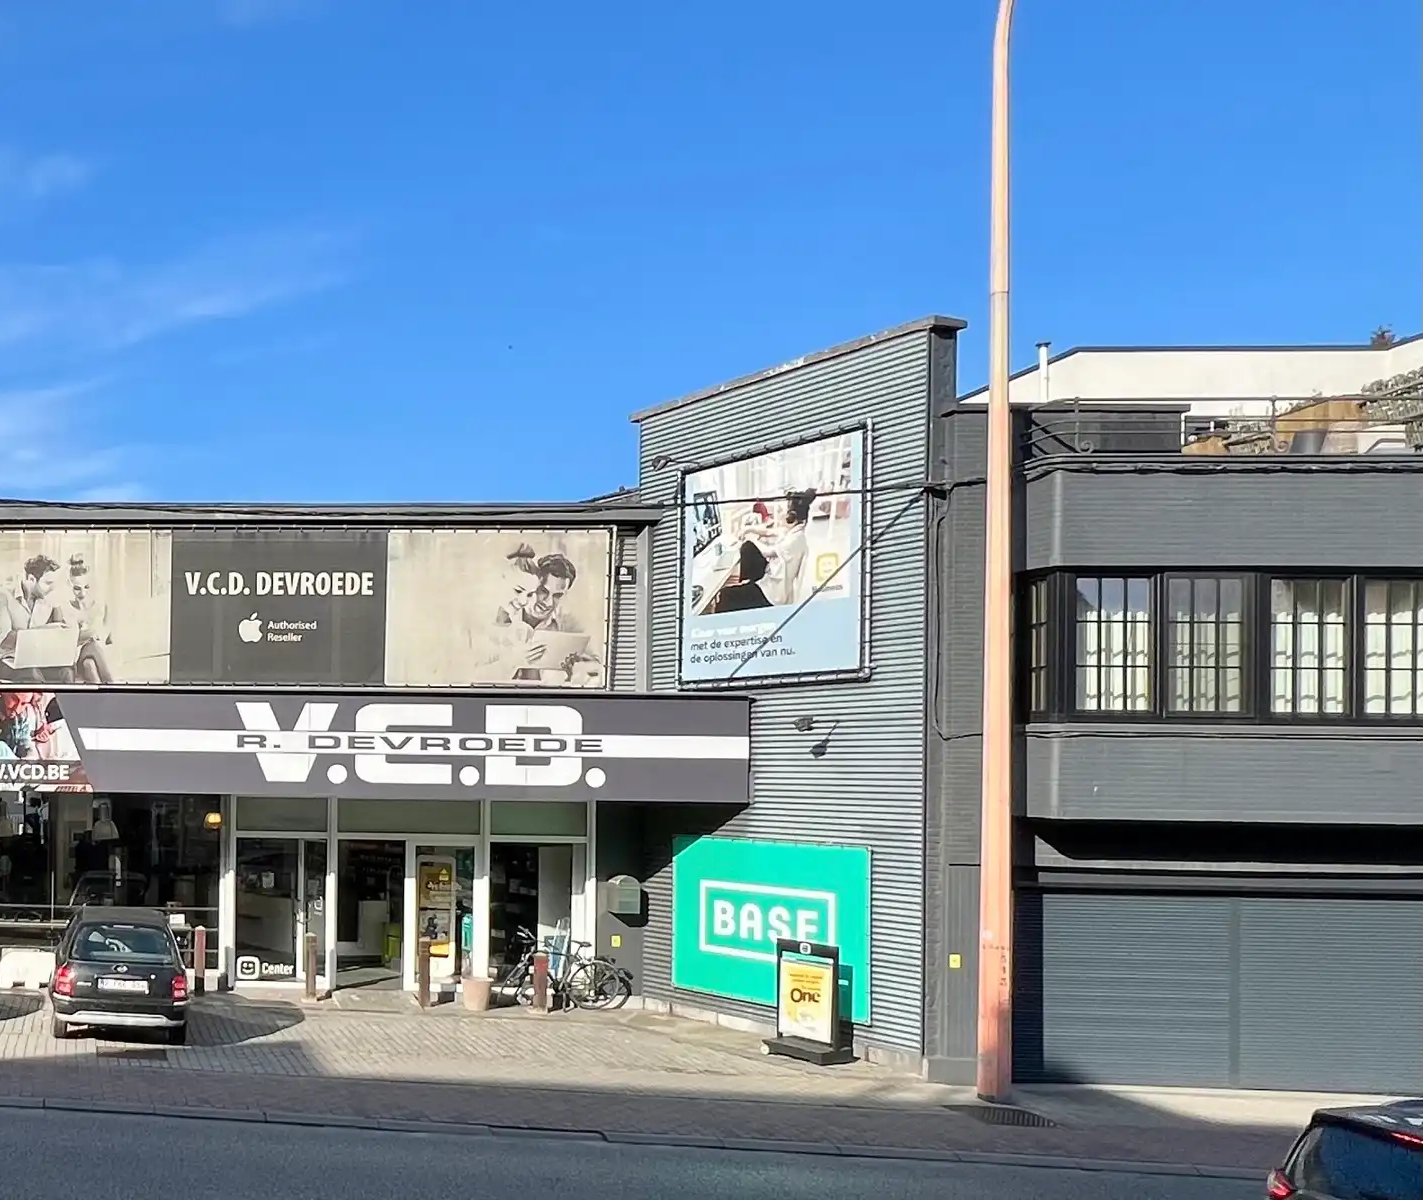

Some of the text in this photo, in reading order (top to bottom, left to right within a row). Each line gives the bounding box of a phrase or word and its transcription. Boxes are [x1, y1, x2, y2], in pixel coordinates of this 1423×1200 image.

[184, 571, 374, 596] V.C.D. DEVROEDE
[267, 620, 317, 631] Authorised
[267, 632, 303, 643] Reseller
[690, 641, 708, 651] met
[710, 639, 722, 649] de
[690, 653, 701, 664] de
[760, 648, 778, 658] van
[236, 733, 604, 754] R. DEVROEDE
[713, 899, 819, 944] BASE
[261, 962, 295, 975] Center
[790, 987, 822, 1003] One
